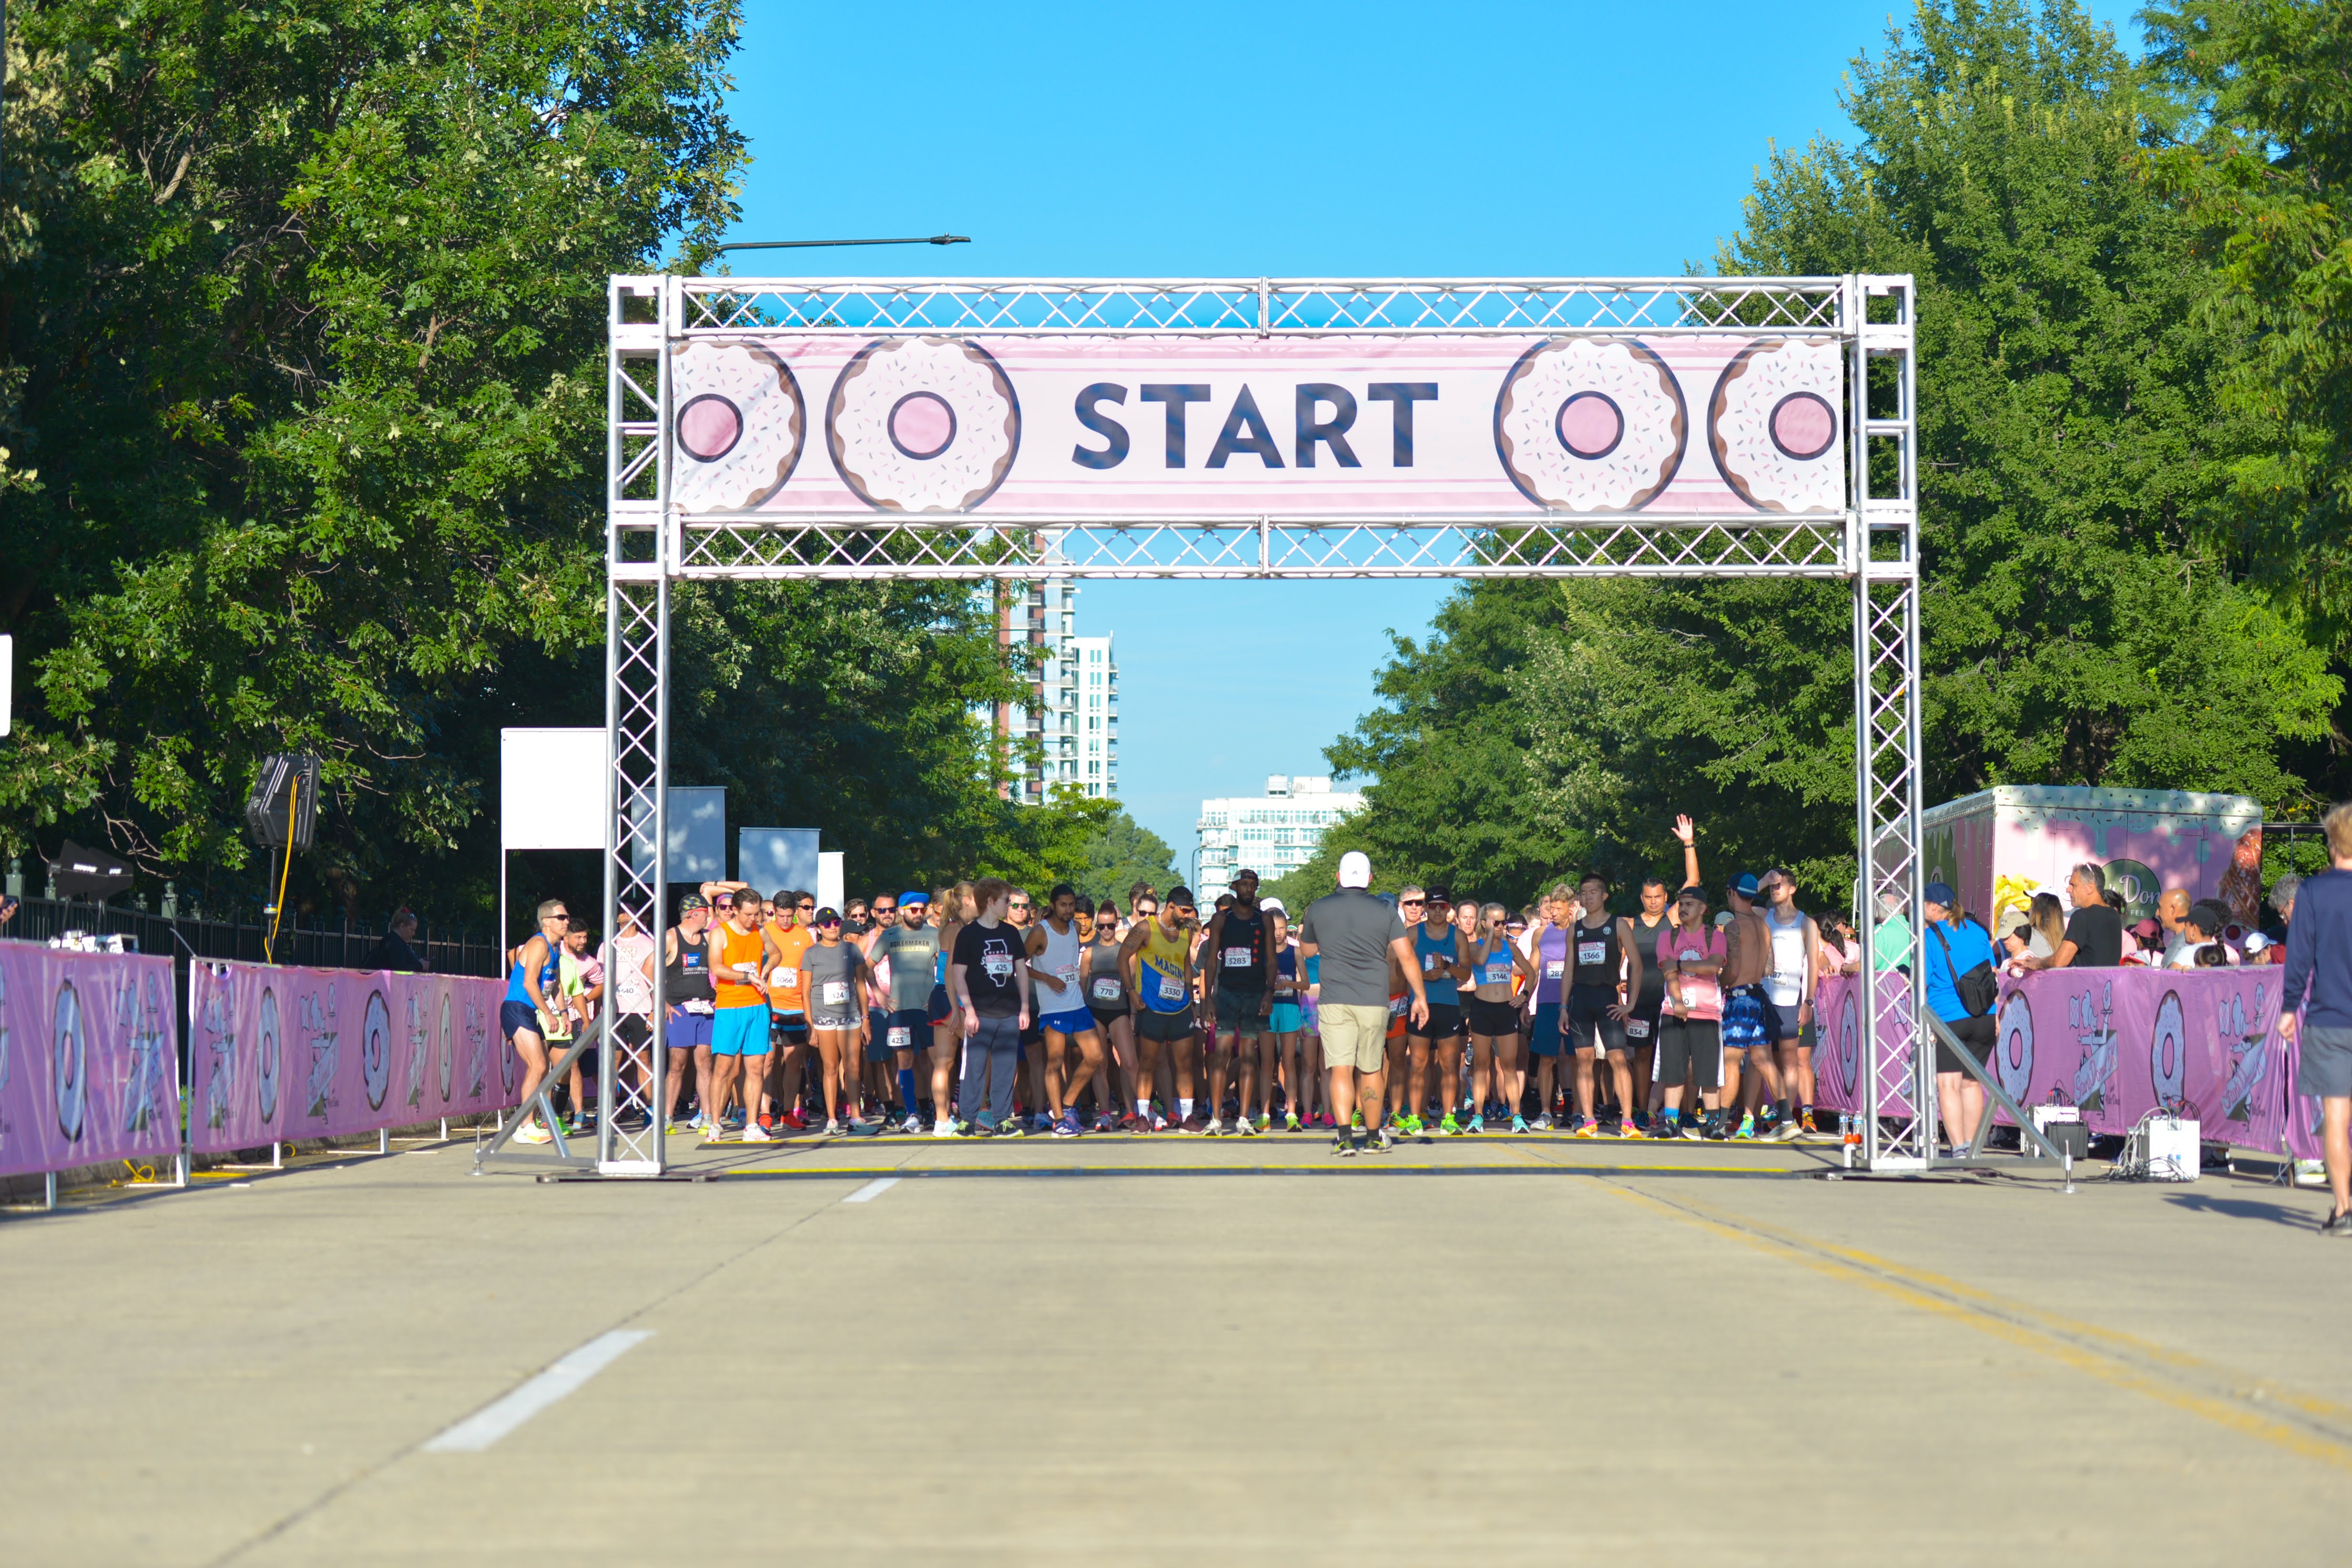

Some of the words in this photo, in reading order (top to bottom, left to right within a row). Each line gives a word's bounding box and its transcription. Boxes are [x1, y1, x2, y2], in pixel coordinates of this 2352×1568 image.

[1072, 382, 1439, 470] START
[2119, 874, 2161, 904] Don
[1583, 952, 1600, 960] 1366
[1155, 954, 1184, 980] MAGIN
[1065, 974, 1075, 982] 312
[1101, 987, 1114, 996] 778
[1164, 987, 1180, 996] 3330
